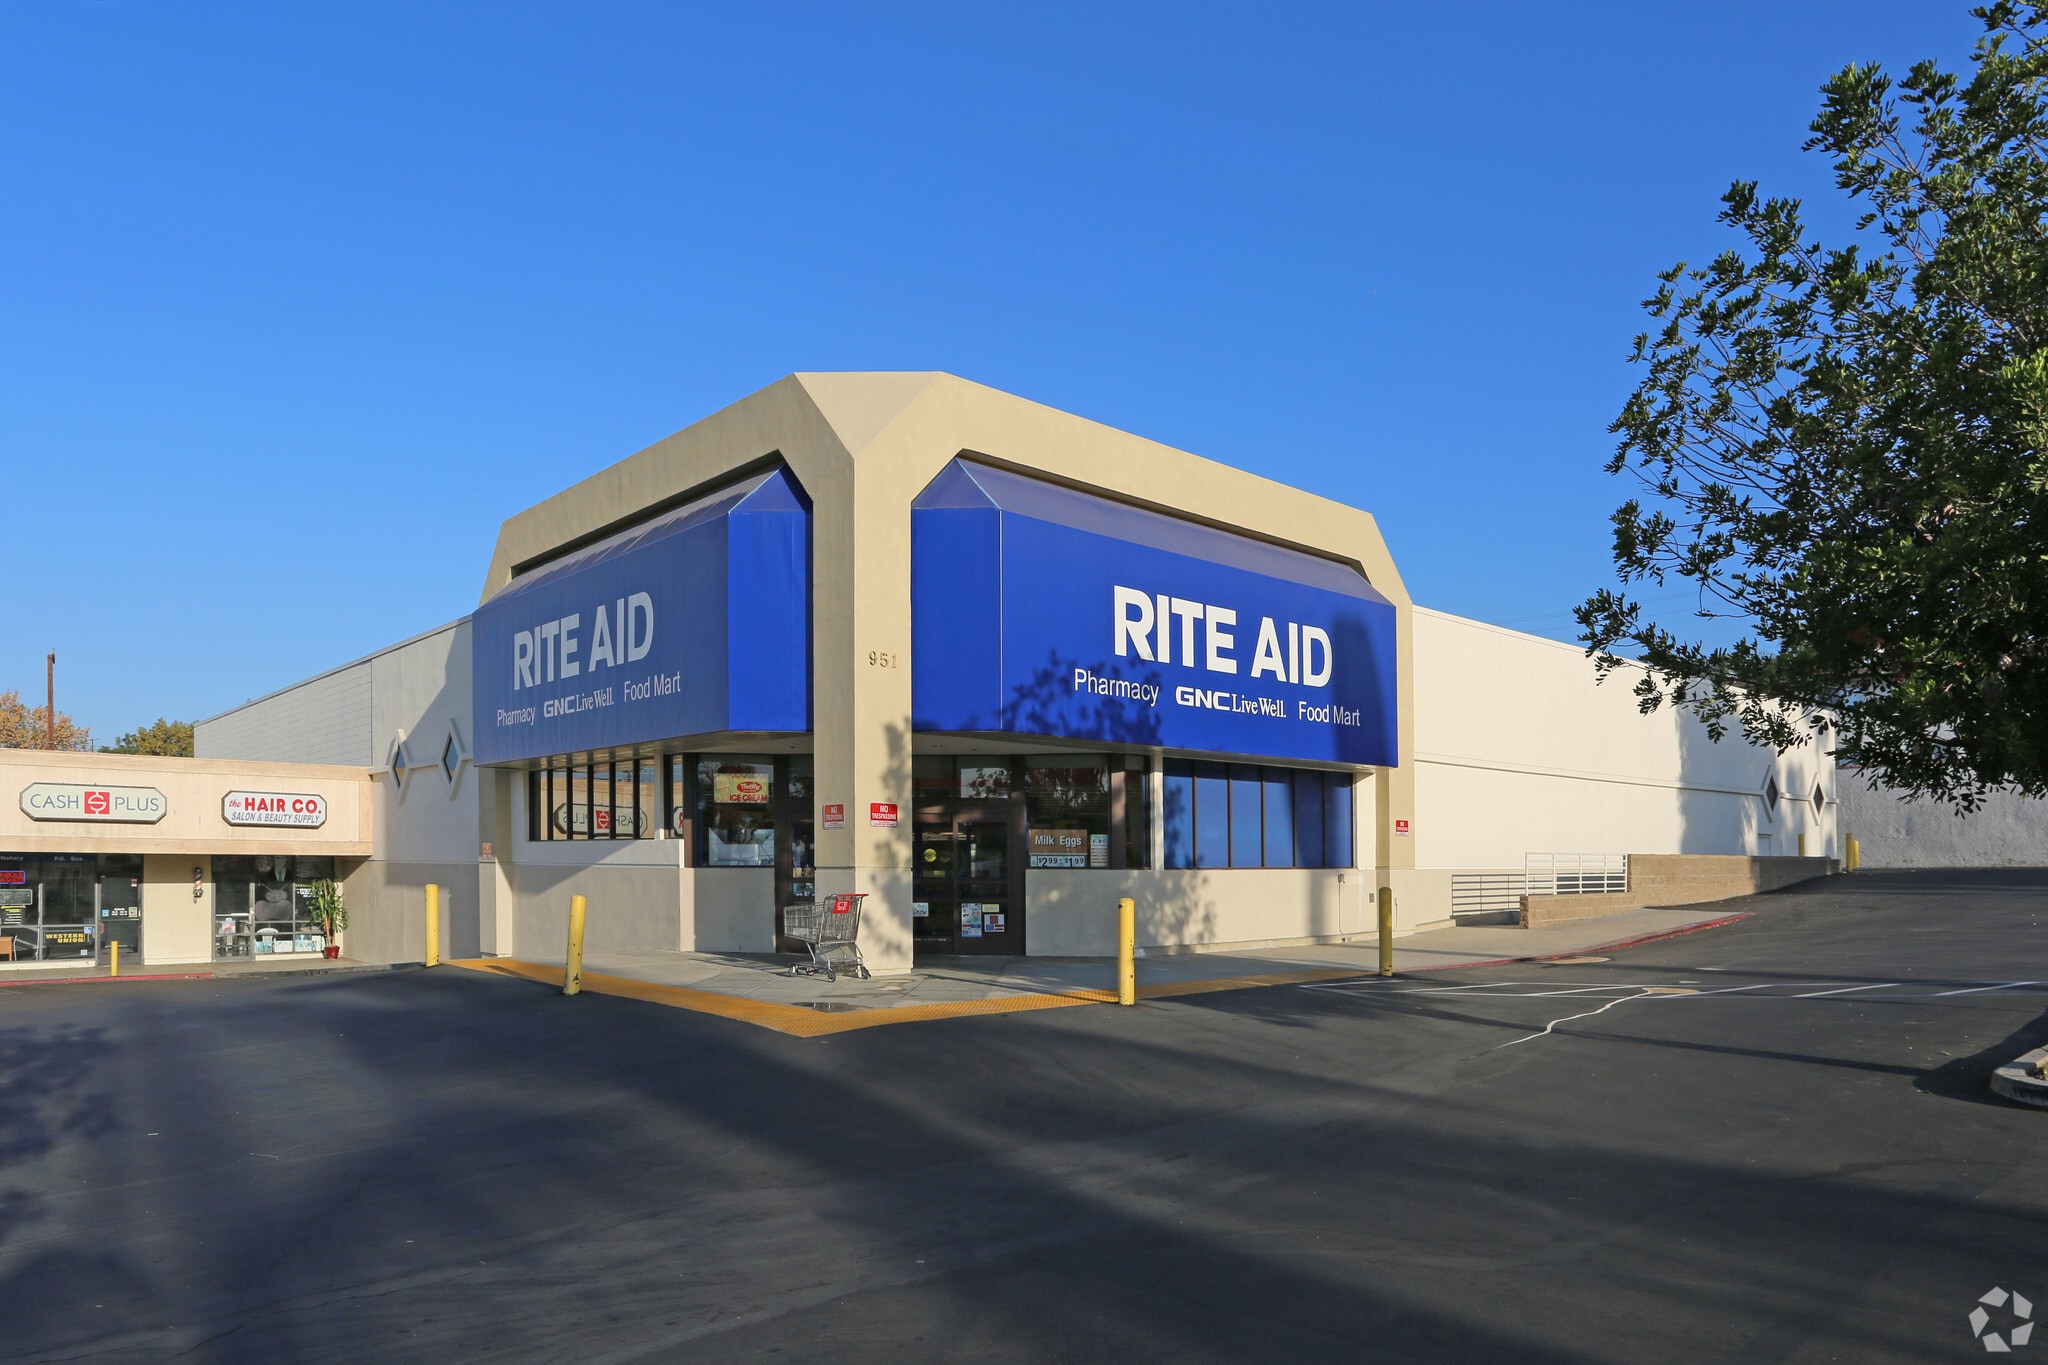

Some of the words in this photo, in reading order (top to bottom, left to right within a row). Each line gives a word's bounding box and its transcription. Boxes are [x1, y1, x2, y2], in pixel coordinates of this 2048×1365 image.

[513, 612, 580, 691] RITE
[588, 591, 654, 673] AID
[1113, 585, 1237, 674] RITE
[1251, 616, 1333, 687] AID
[868, 650, 897, 669] 951
[497, 706, 536, 727] Pharmacy
[624, 677, 651, 702] Food
[654, 671, 681, 696] Mart
[1074, 668, 1159, 707] Pharmacy
[1299, 701, 1330, 723] Food
[1333, 706, 1361, 726] Mart
[30, 793, 79, 809] CASH
[114, 796, 159, 812] PLUS
[229, 799, 241, 808] the
[244, 797, 286, 812] HAIR
[291, 799, 322, 814] CO.
[729, 794, 742, 802] ICE
[742, 794, 768, 802] CREAM
[231, 811, 256, 821] SALON
[257, 813, 263, 822] &
[264, 813, 292, 823] BEAUTY
[293, 814, 320, 824] SUPPLY
[880, 805, 889, 813] NO
[1034, 835, 1055, 845] Milk
[1060, 835, 1082, 848] Eggs
